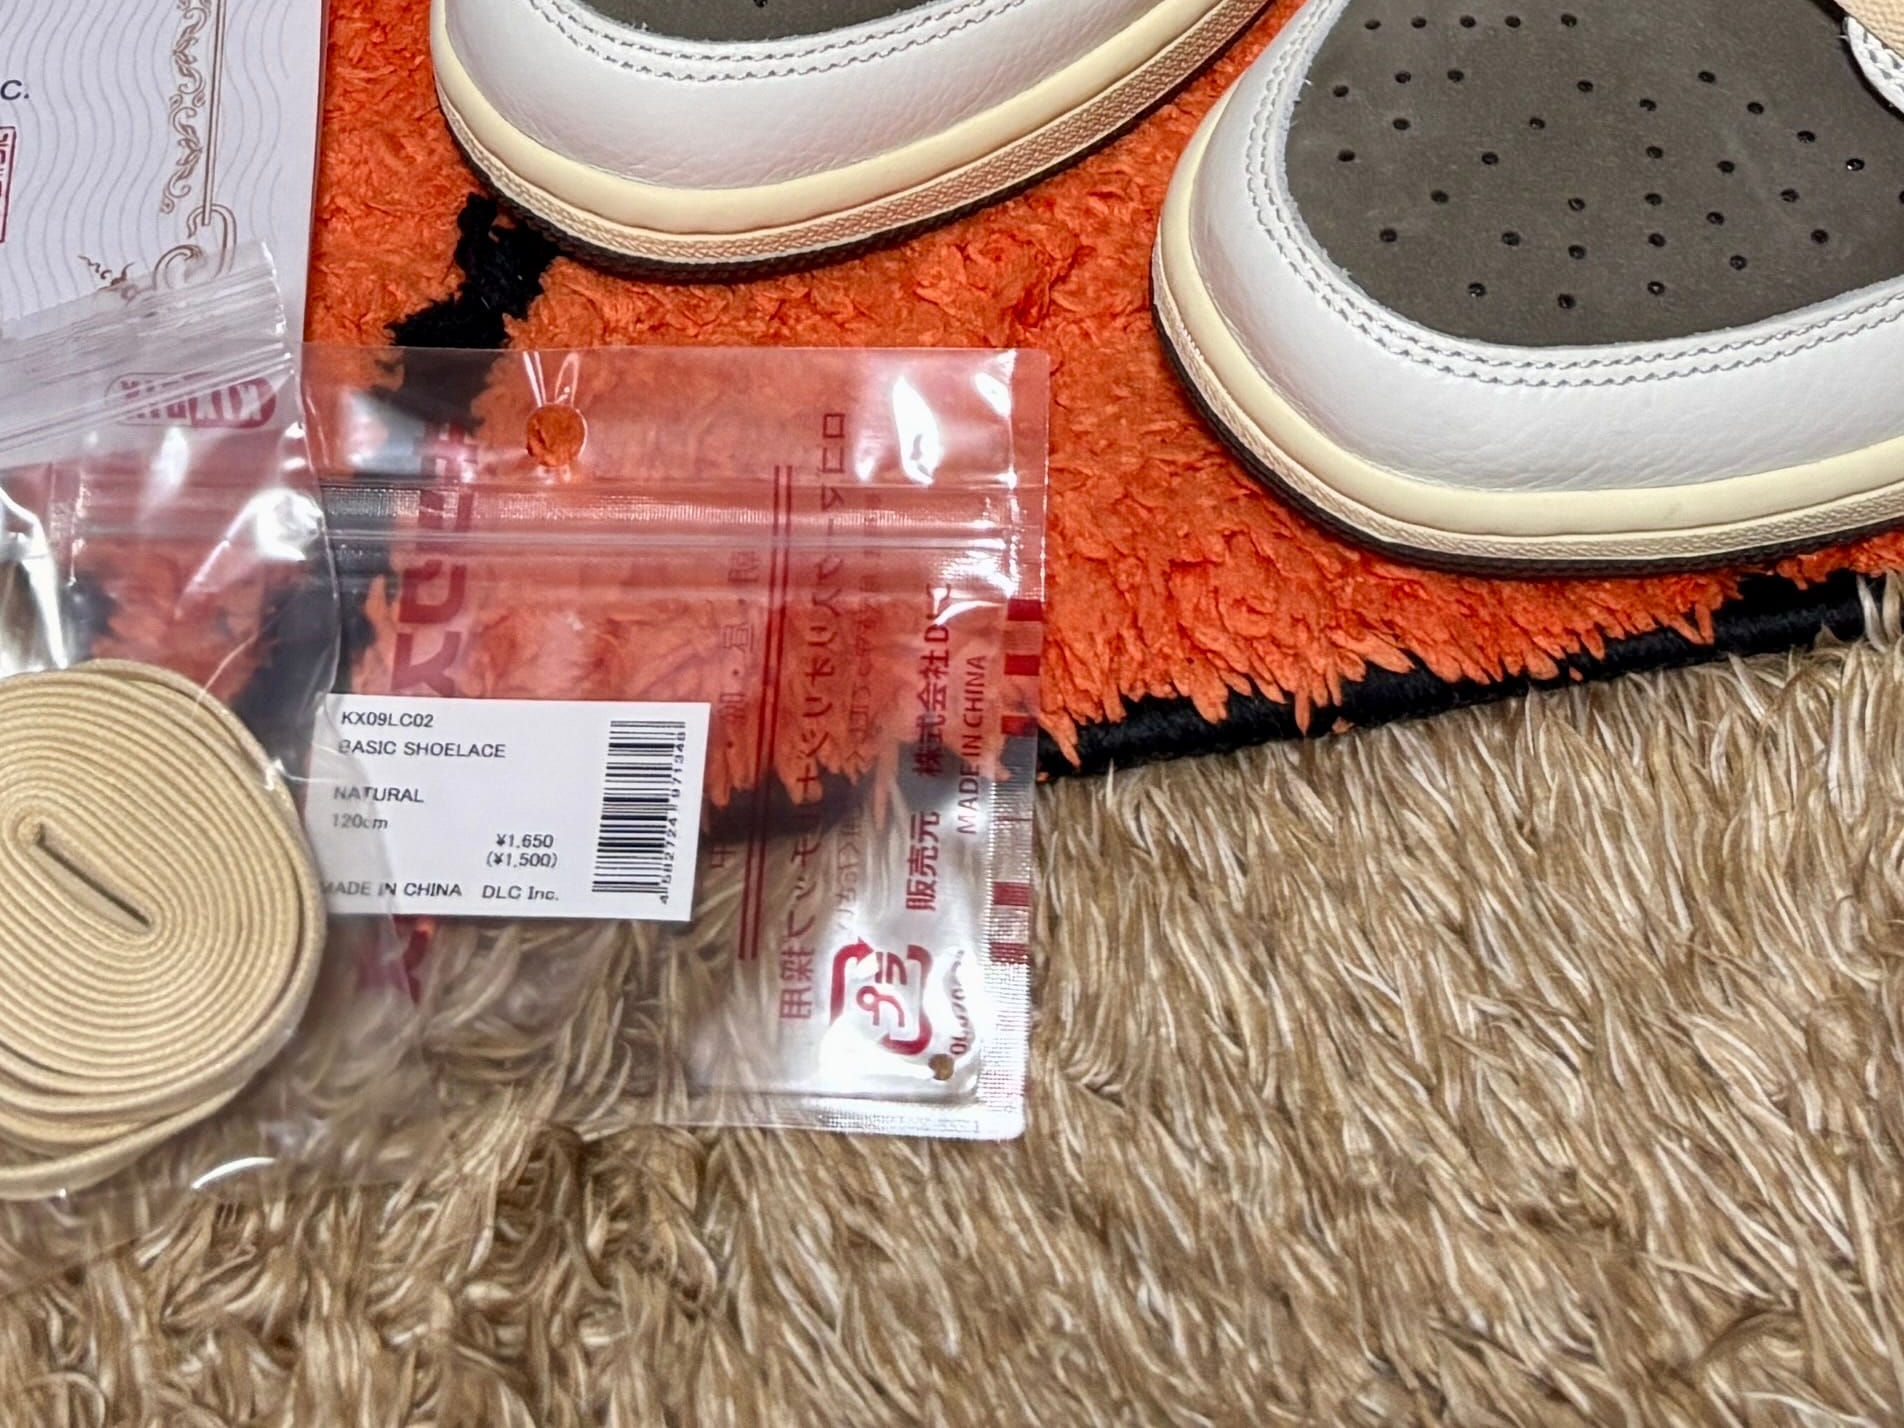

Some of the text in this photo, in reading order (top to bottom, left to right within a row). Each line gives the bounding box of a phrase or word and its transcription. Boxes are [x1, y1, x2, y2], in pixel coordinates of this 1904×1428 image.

[340, 711, 434, 729] KX09LC02
[338, 739, 506, 759] BASIC SHOELACE
[954, 655, 987, 835] MADE IN CHINA
[333, 786, 424, 804] NATURAL
[331, 813, 389, 831] 120cm
[904, 810, 941, 913] 販売元
[377, 881, 397, 897] IN
[403, 882, 463, 898] CHINA
[481, 884, 522, 901] DLC
[527, 885, 560, 902] Inc.
